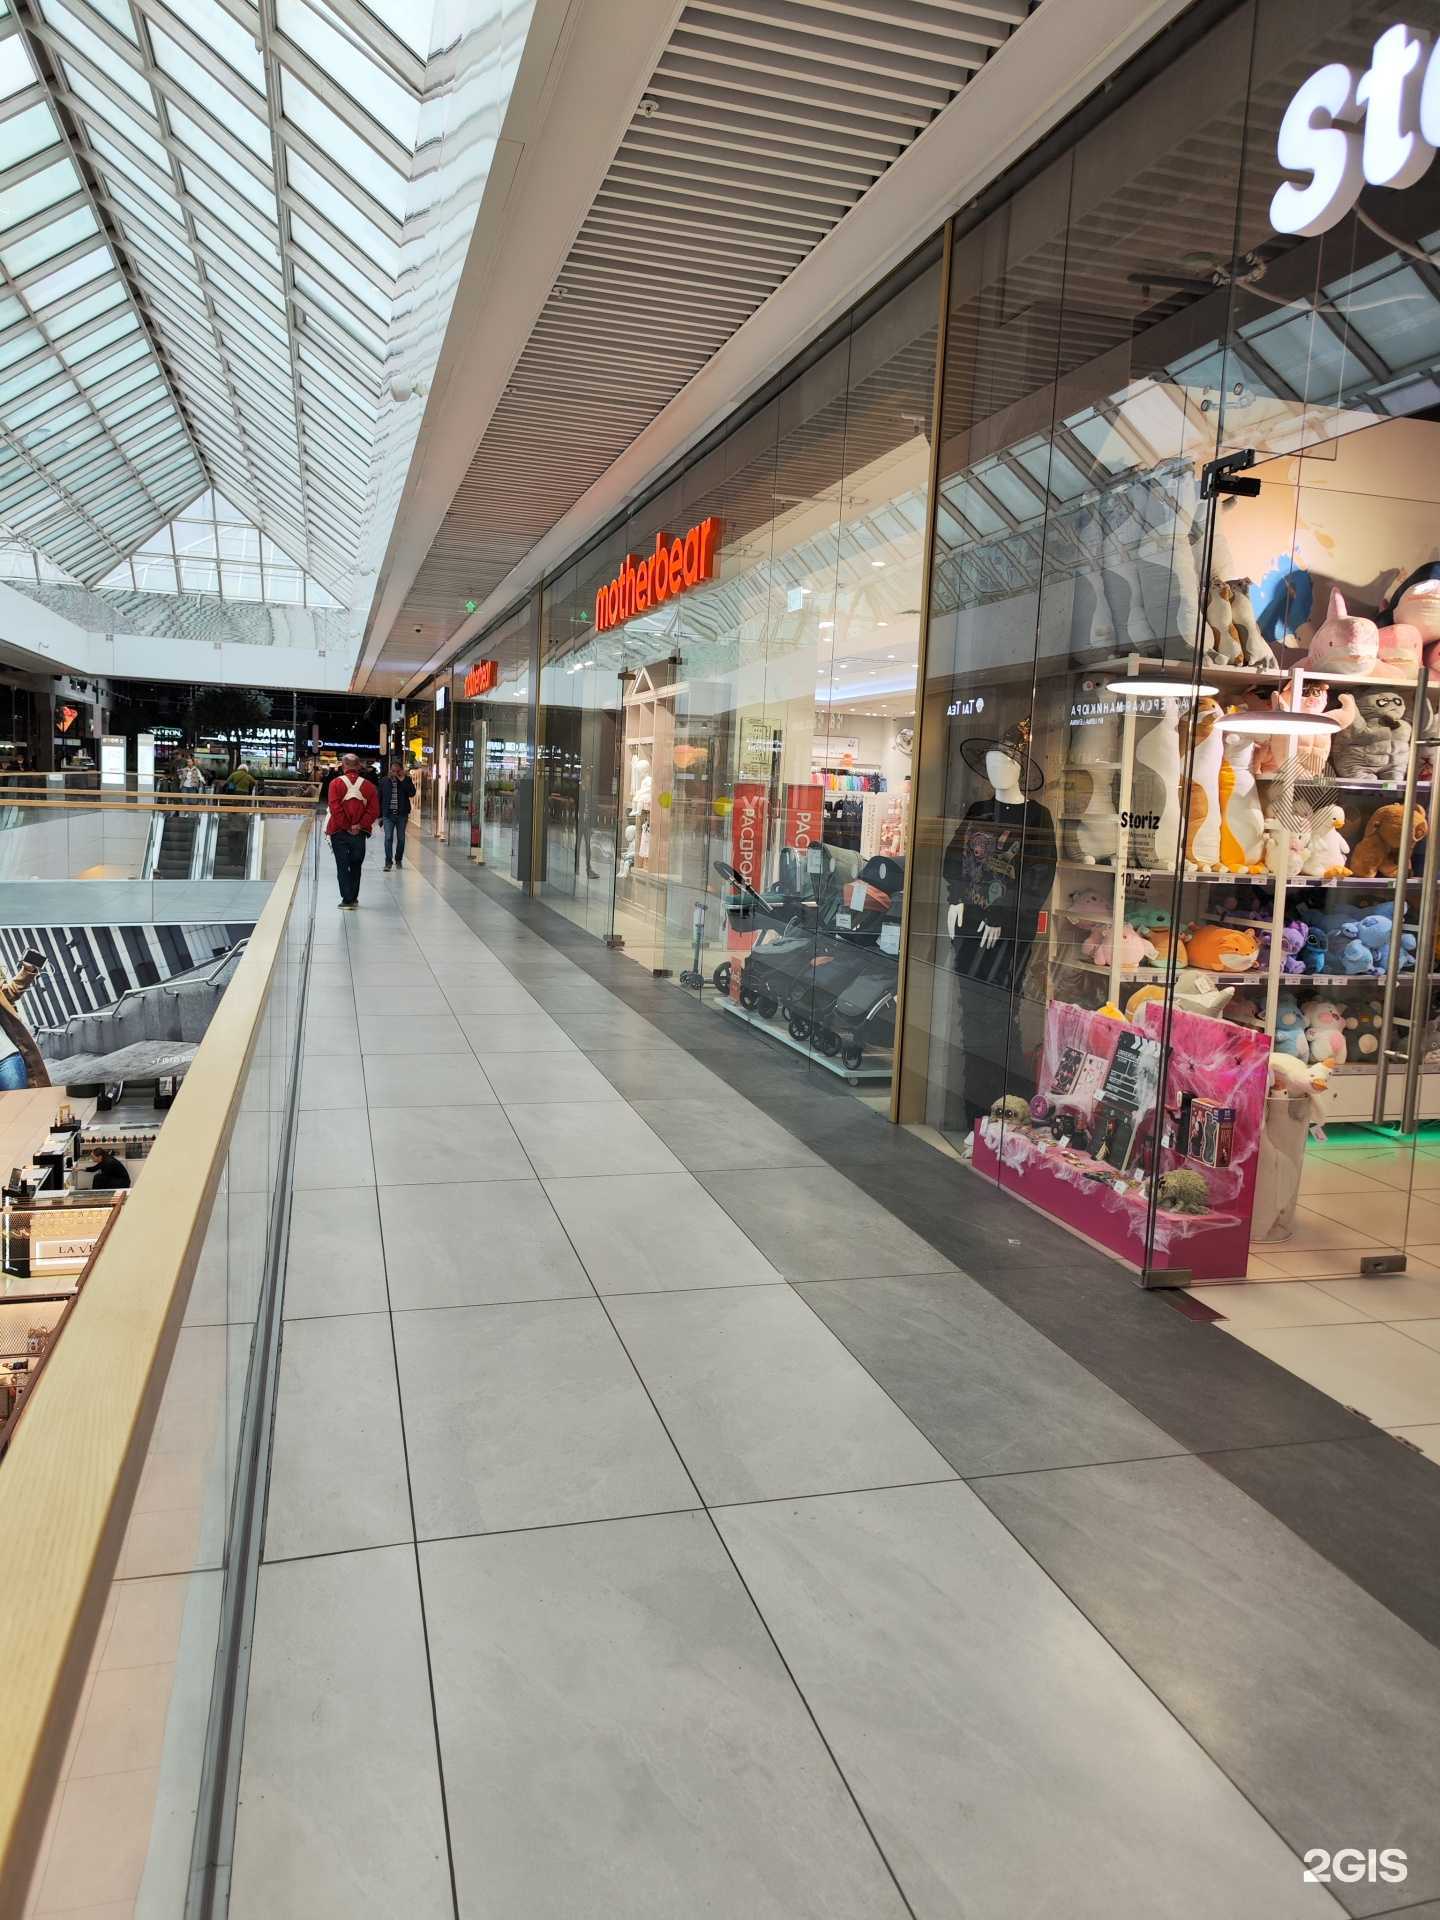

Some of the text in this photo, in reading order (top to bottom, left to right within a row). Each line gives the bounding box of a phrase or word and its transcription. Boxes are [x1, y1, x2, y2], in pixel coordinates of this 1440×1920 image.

[1269, 23, 1440, 235] St
[595, 516, 715, 632] motherbear
[1120, 811, 1160, 829] Storiz
[1121, 872, 1132, 887] 10
[1138, 874, 1151, 889] 22
[59, 1246, 74, 1254] LA
